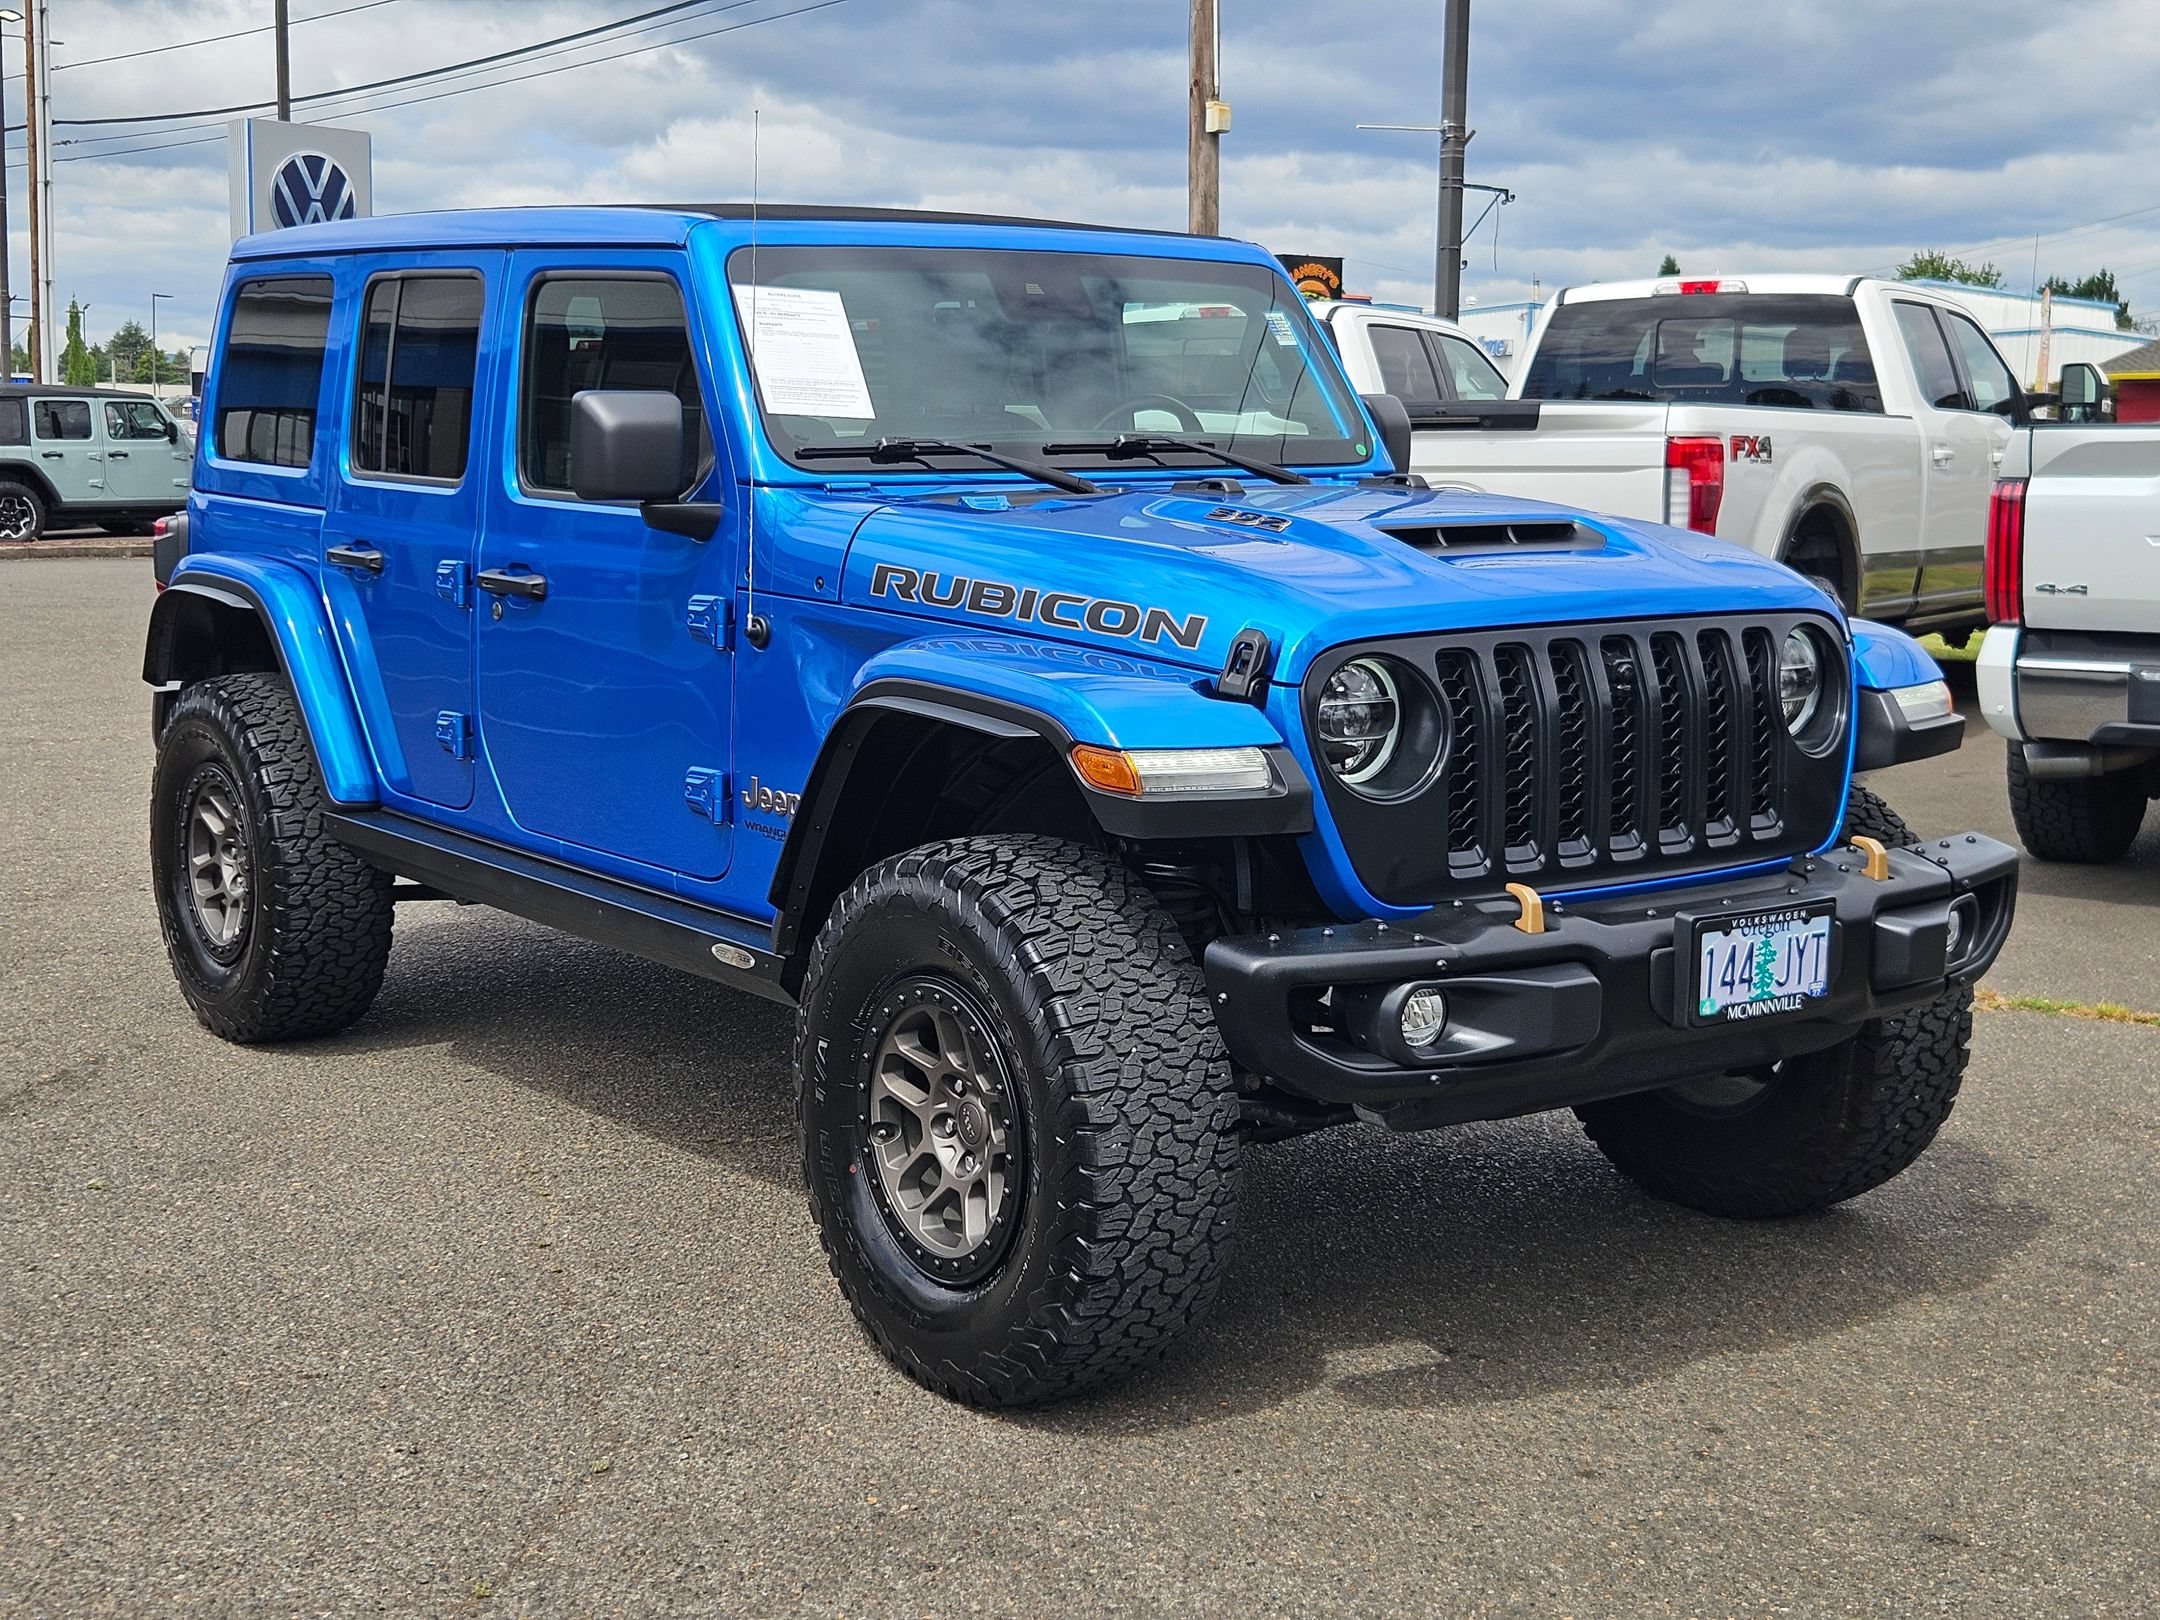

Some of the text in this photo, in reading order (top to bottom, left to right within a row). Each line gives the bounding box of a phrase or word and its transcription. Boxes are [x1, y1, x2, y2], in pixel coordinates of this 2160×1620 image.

[1729, 434, 1772, 463] FX4
[1204, 507, 1292, 534] 392
[870, 562, 1209, 651] RUBICON
[1731, 910, 1807, 928] VOLKSWAGEN
[1706, 931, 1826, 999] 144 JYT
[1726, 993, 1803, 1021] MCMINNVILLE
